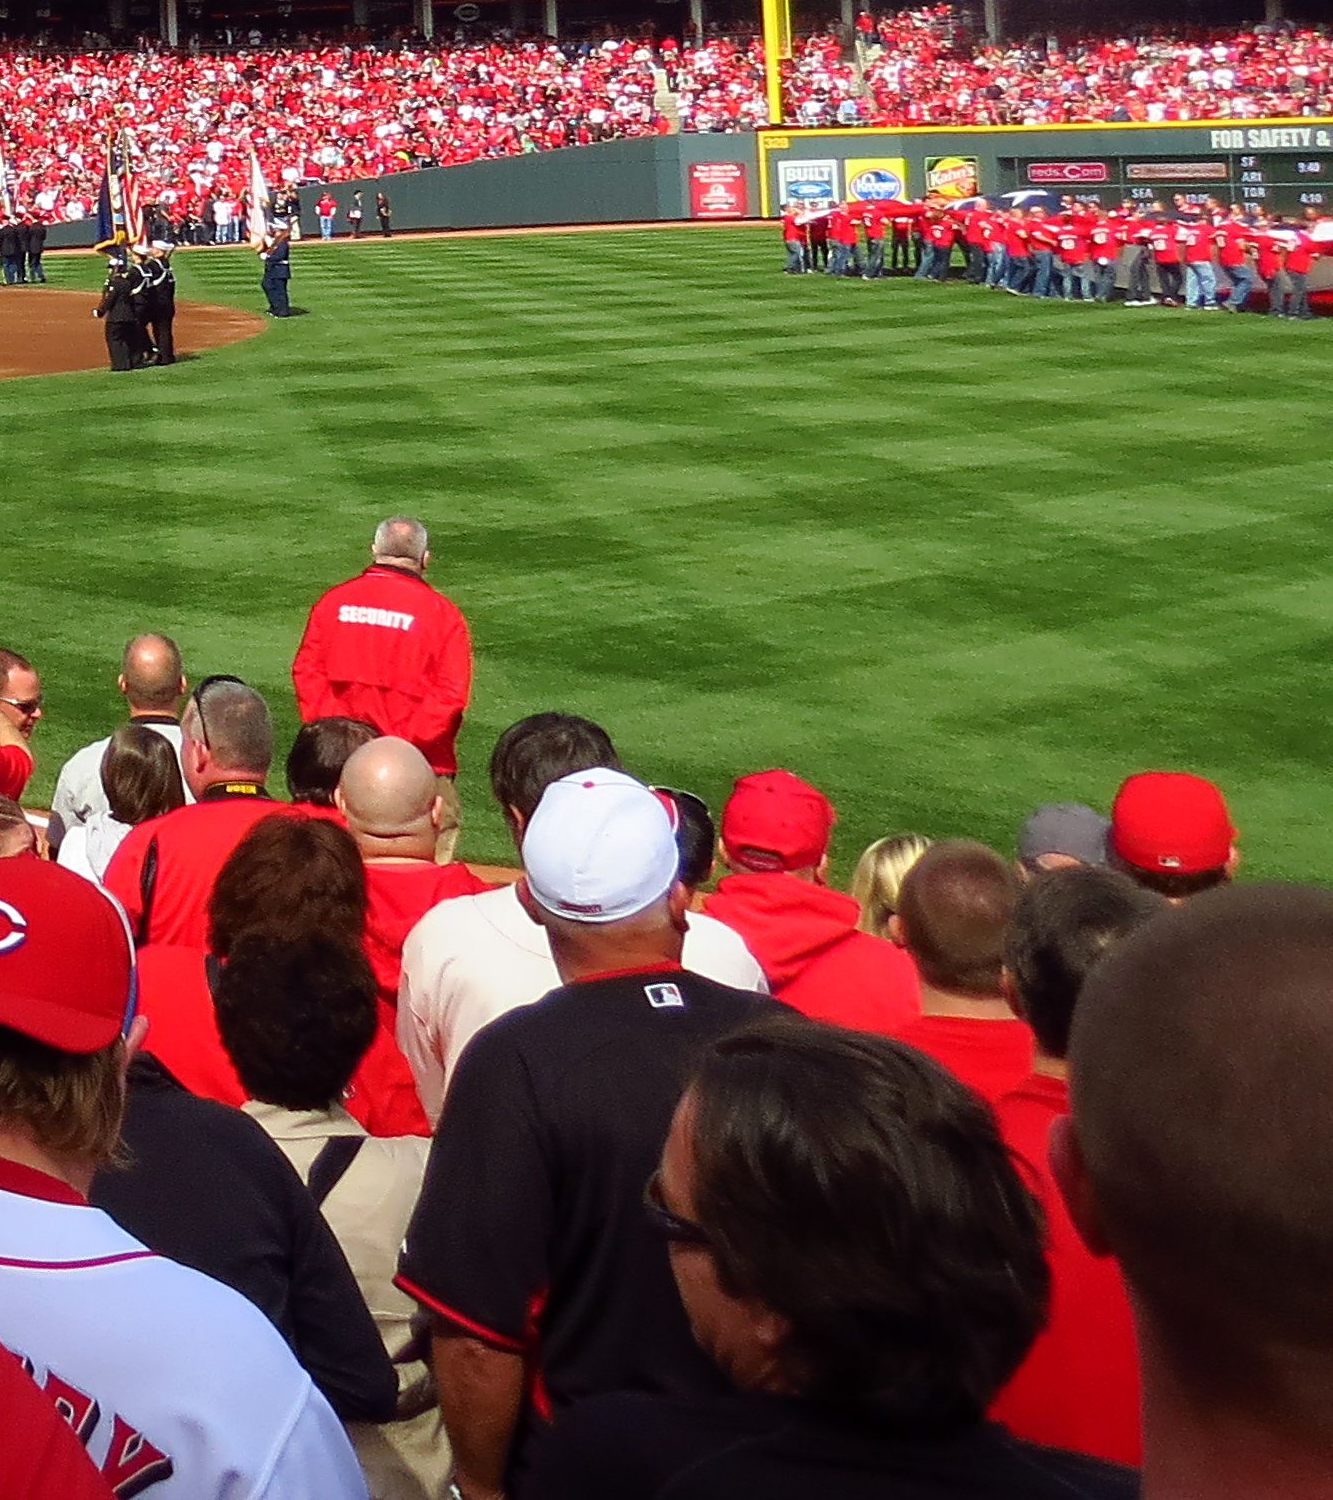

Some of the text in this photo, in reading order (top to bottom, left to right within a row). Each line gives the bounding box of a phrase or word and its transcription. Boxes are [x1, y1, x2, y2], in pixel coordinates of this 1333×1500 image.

[1211, 128, 1331, 149] FOR SAFETY &
[1240, 156, 1256, 168] SF
[786, 165, 830, 182] BUILT
[930, 164, 976, 187] Kahn's
[1241, 171, 1262, 182] ARI
[855, 173, 900, 195] Kroger
[1131, 188, 1153, 199] SEA
[338, 604, 415, 632] SECURITY
